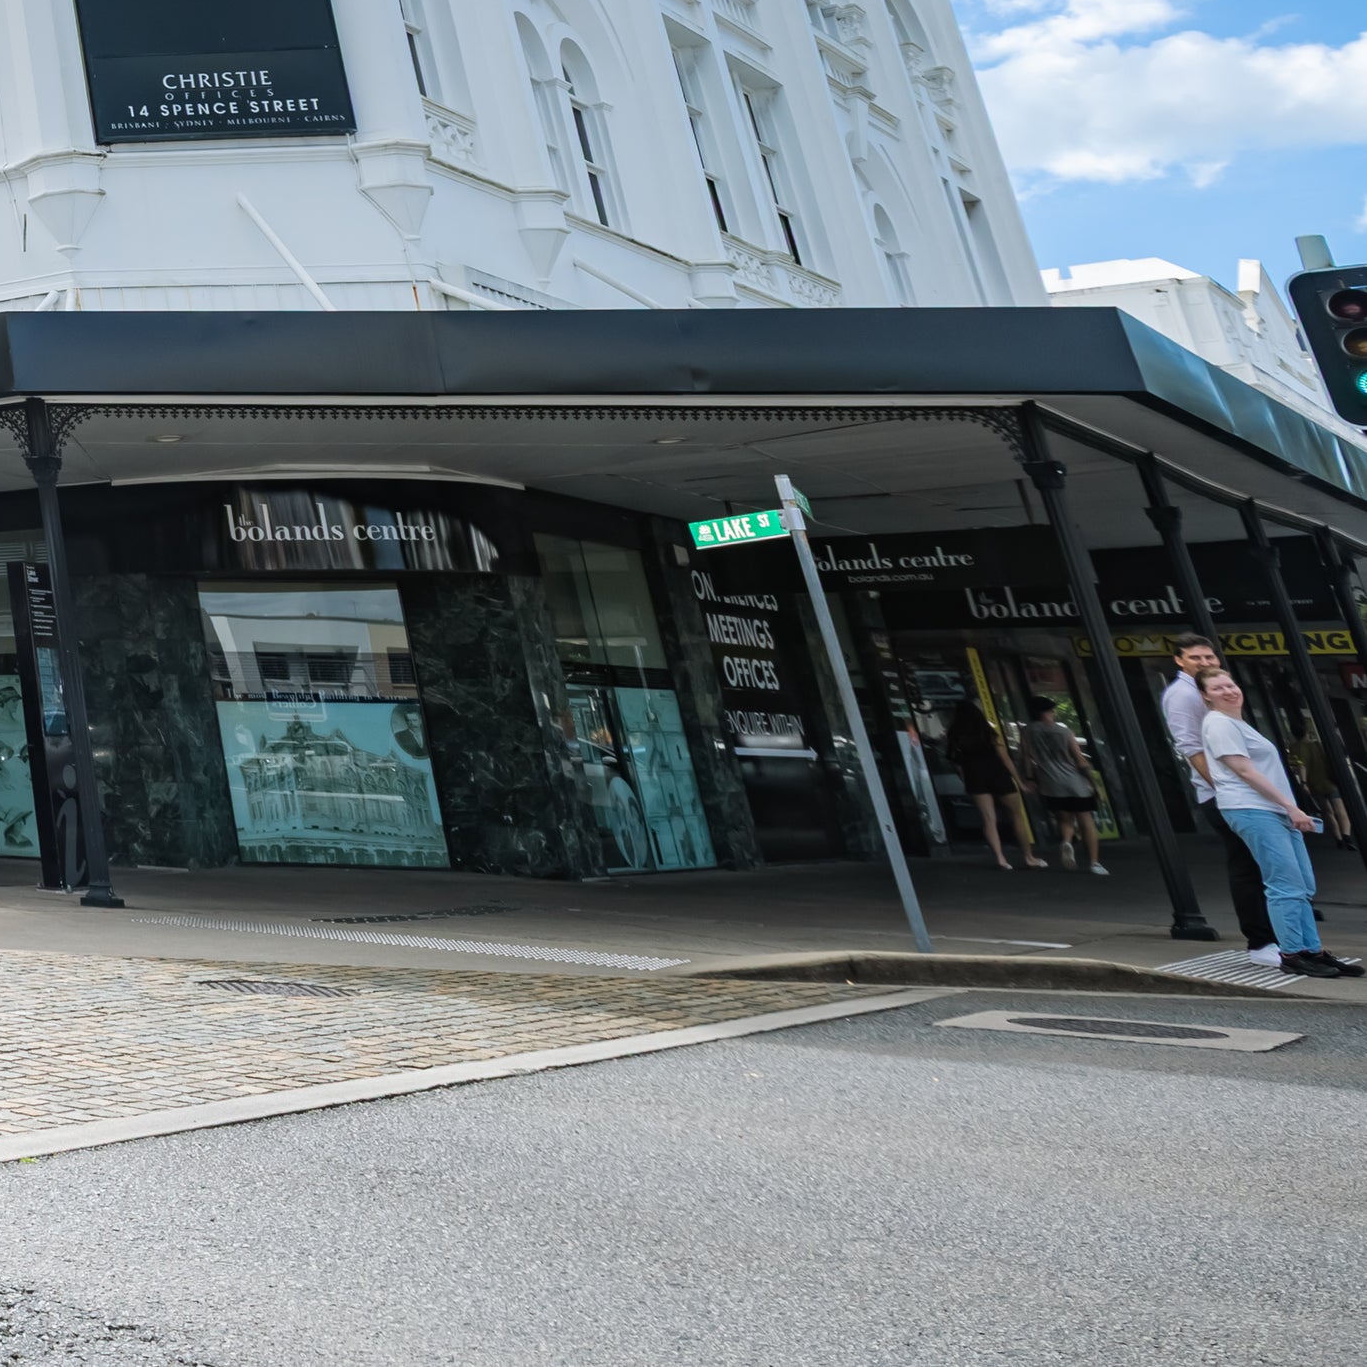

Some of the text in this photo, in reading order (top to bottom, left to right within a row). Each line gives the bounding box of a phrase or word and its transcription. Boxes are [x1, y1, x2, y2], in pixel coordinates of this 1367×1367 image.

[162, 70, 272, 90] CHRISTIE
[127, 97, 321, 117] 14 SPENCE STREET
[164, 89, 274, 101] OFFICES
[110, 121, 160, 130] BRISBANE
[173, 118, 214, 131] SYDNEY
[304, 114, 346, 124] CAIRNS
[224, 503, 436, 542] bolands centre
[712, 514, 771, 542] LAKE ST
[817, 543, 975, 572] olands centre
[964, 585, 1225, 619] boland cente
[705, 612, 775, 650] MEETINGS
[723, 655, 780, 690] OFFICES
